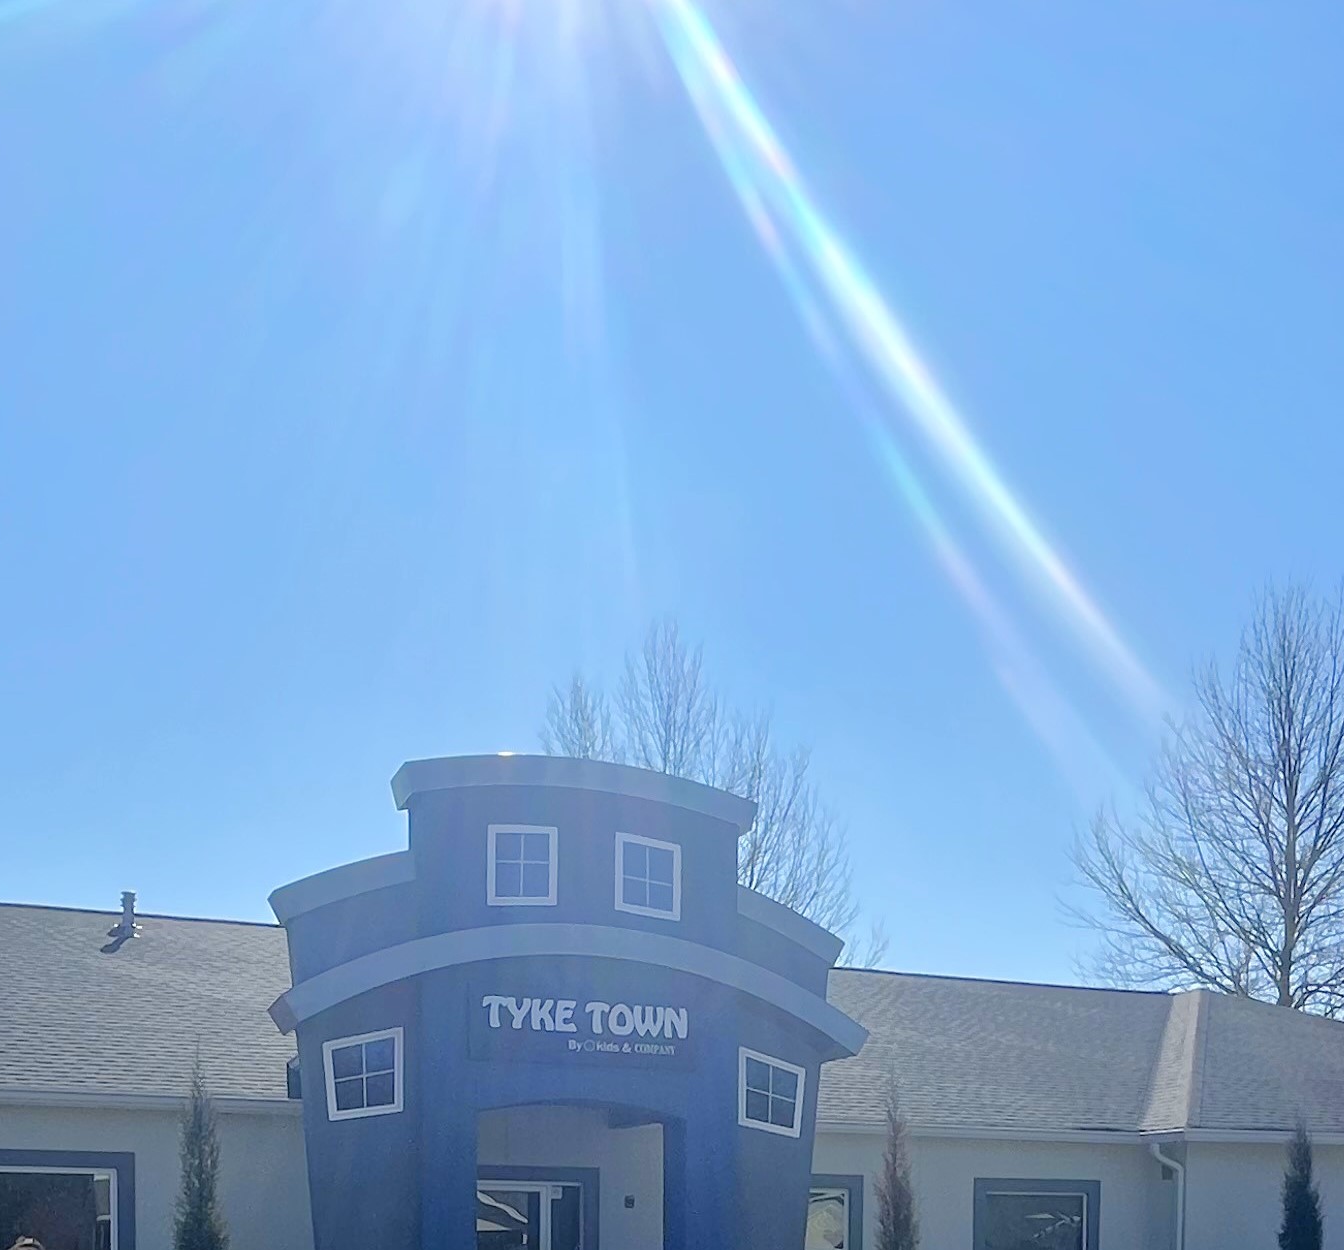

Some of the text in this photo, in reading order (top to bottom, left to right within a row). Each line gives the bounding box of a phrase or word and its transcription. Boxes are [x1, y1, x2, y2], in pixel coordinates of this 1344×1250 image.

[482, 995, 689, 1039] TYKE TOWN
[568, 1040, 583, 1053] By
[621, 1042, 632, 1053] &
